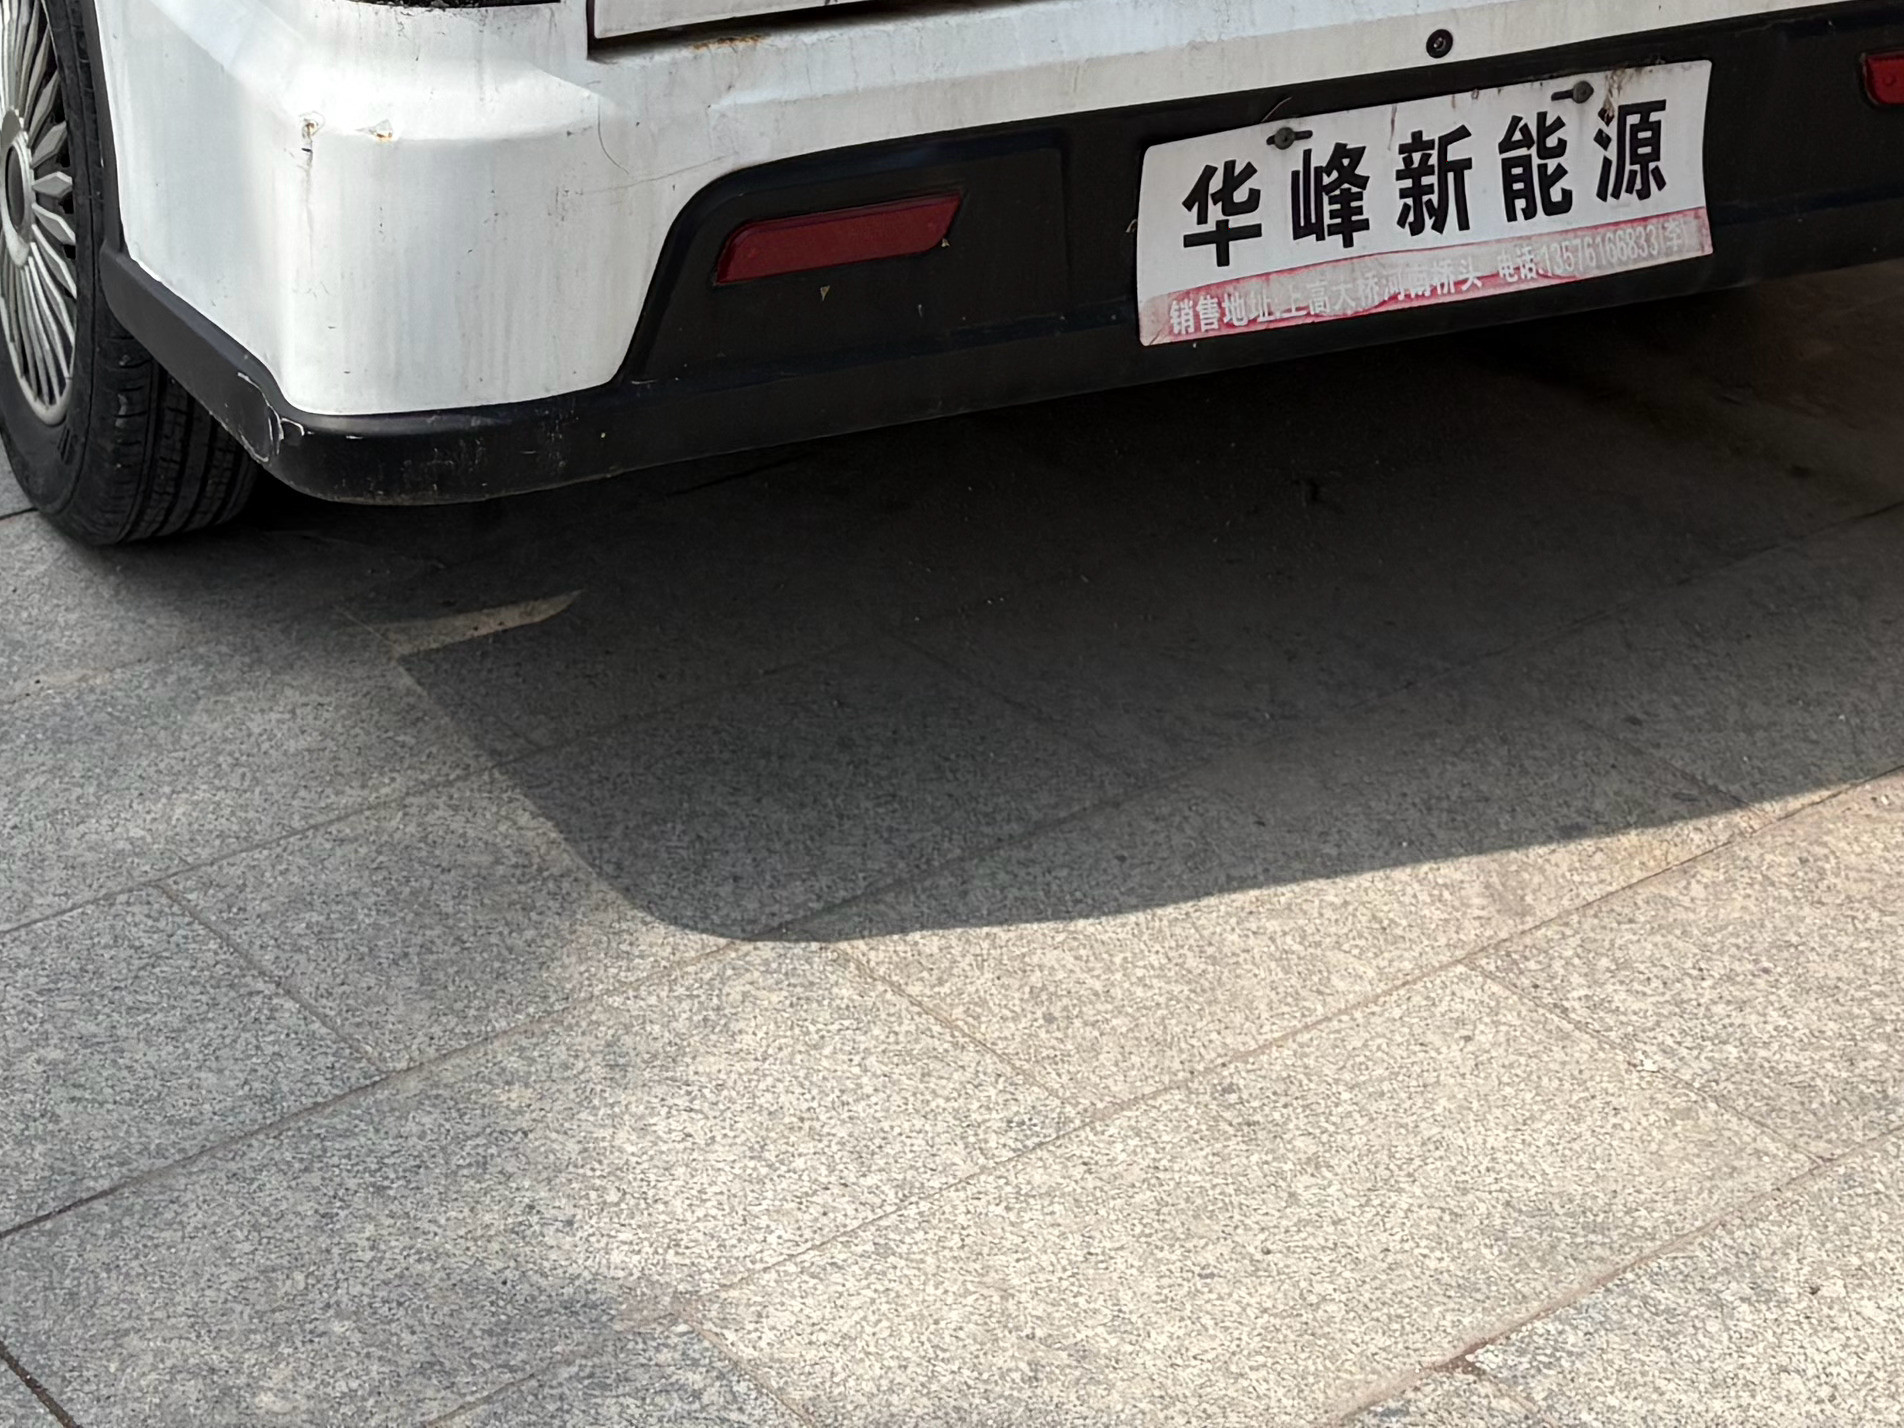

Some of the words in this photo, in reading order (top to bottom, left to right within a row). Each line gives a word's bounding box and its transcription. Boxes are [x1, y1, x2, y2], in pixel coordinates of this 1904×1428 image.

[1181, 98, 1669, 268] 华峰新能源
